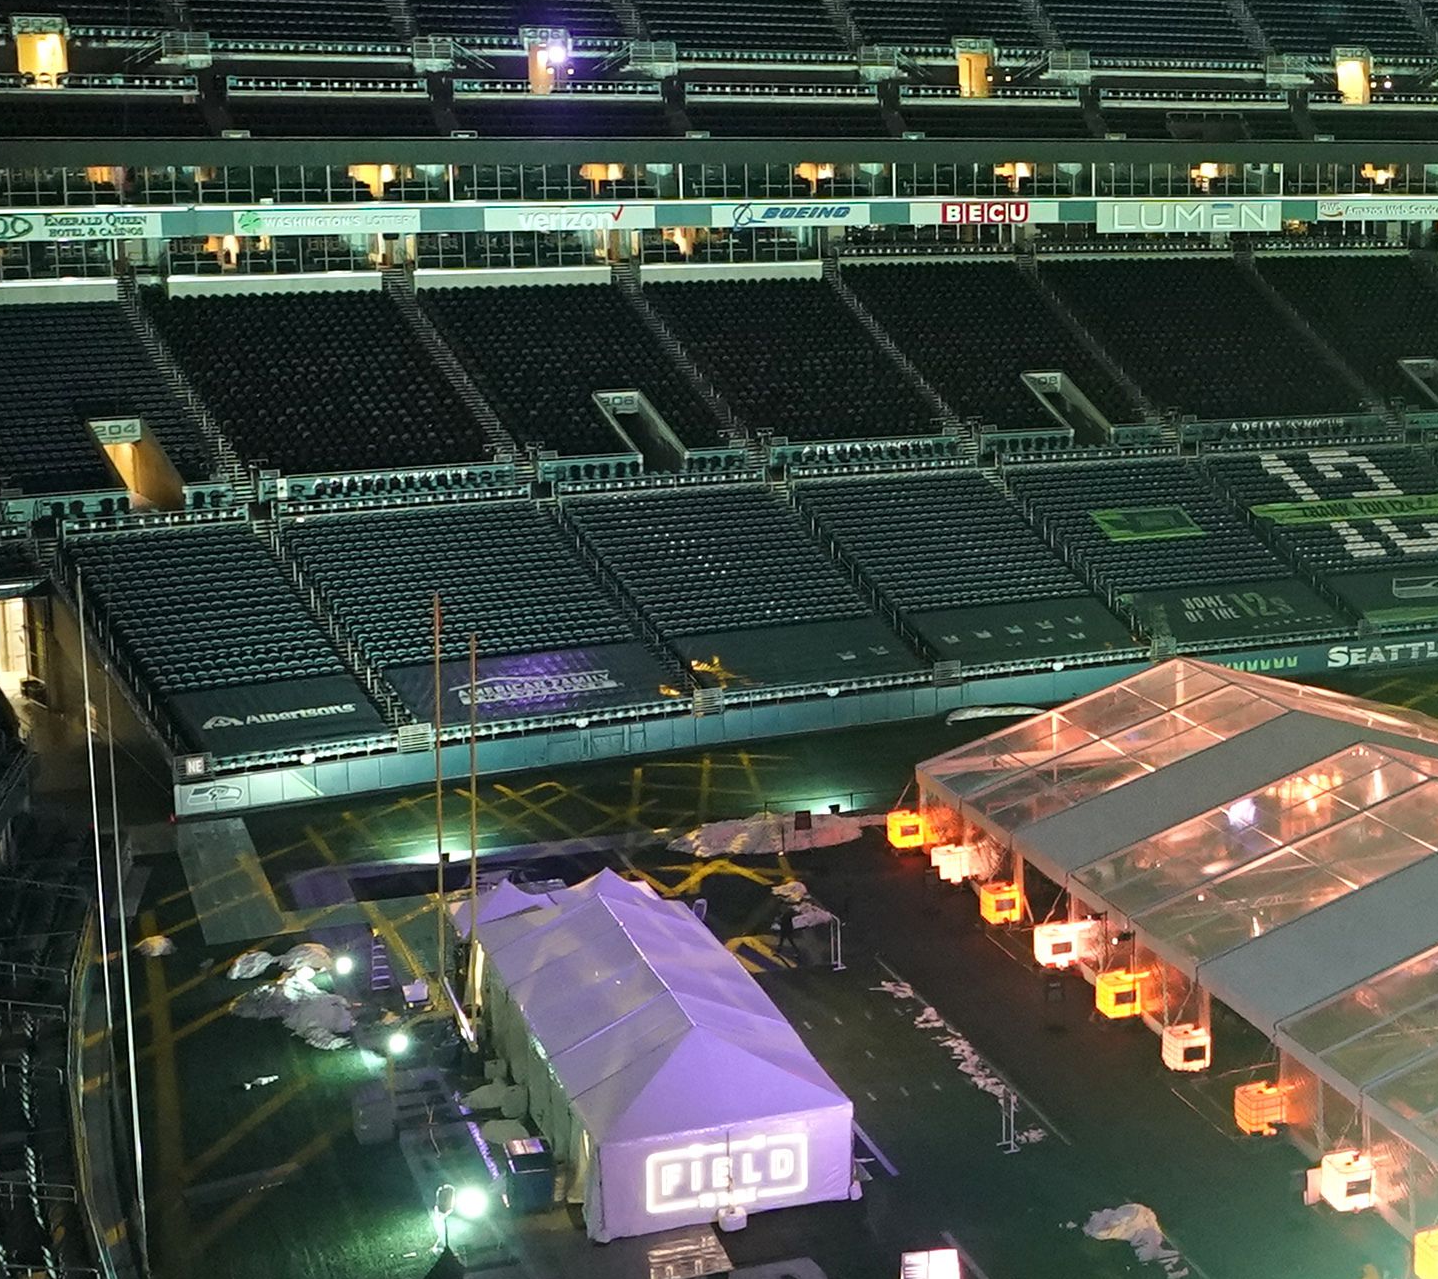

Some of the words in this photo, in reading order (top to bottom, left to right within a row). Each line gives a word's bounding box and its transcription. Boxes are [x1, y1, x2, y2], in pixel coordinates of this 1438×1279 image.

[761, 206, 852, 219] BOEING
[945, 203, 1029, 222] BECU
[1112, 203, 1268, 229] LUMEN
[1345, 204, 1383, 216] Amazon
[44, 214, 103, 227] EMERALD
[105, 212, 147, 227] QUEEN
[518, 210, 613, 231] verizon
[49, 227, 86, 237] HOTEL
[87, 227, 97, 237] &
[98, 225, 144, 237] CASINOS
[93, 424, 138, 436] 204
[245, 703, 357, 726] Albertsons
[187, 759, 203, 774] NE
[661, 1148, 795, 1196] FIELD
